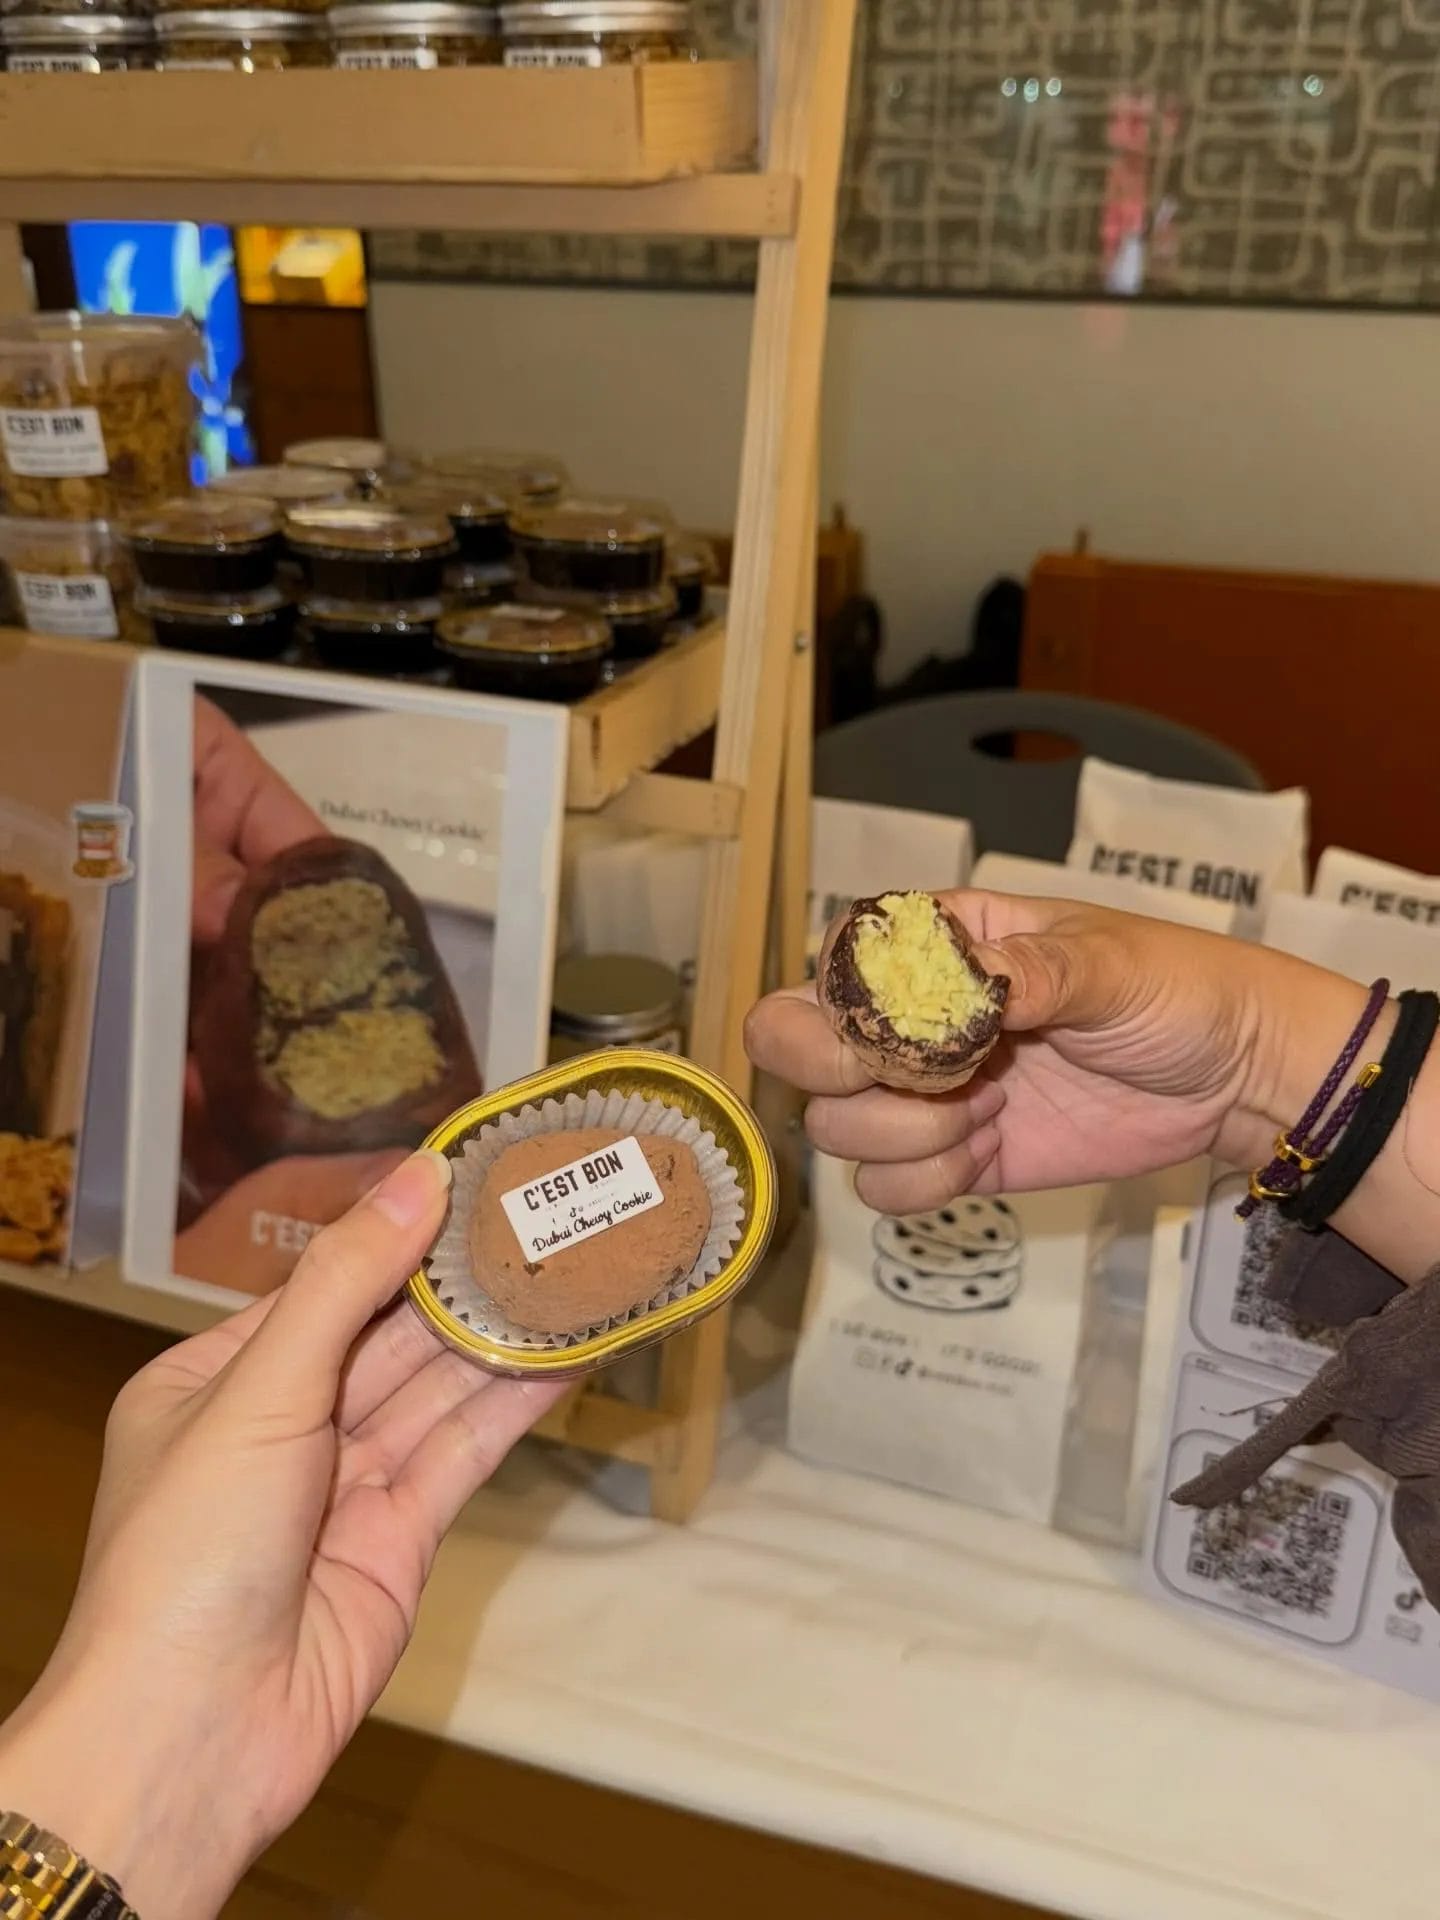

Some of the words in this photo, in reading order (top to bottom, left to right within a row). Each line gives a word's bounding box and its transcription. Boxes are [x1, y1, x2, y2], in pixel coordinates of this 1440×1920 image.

[52, 415, 84, 437] BON
[64, 582, 97, 601] BON
[1190, 860, 1262, 909] BON
[523, 1170, 579, 1211] C'EST
[581, 1150, 624, 1184] BON
[532, 1225, 573, 1252] Dubai
[573, 1208, 613, 1233] Chewy
[613, 1191, 653, 1215] Cookie
